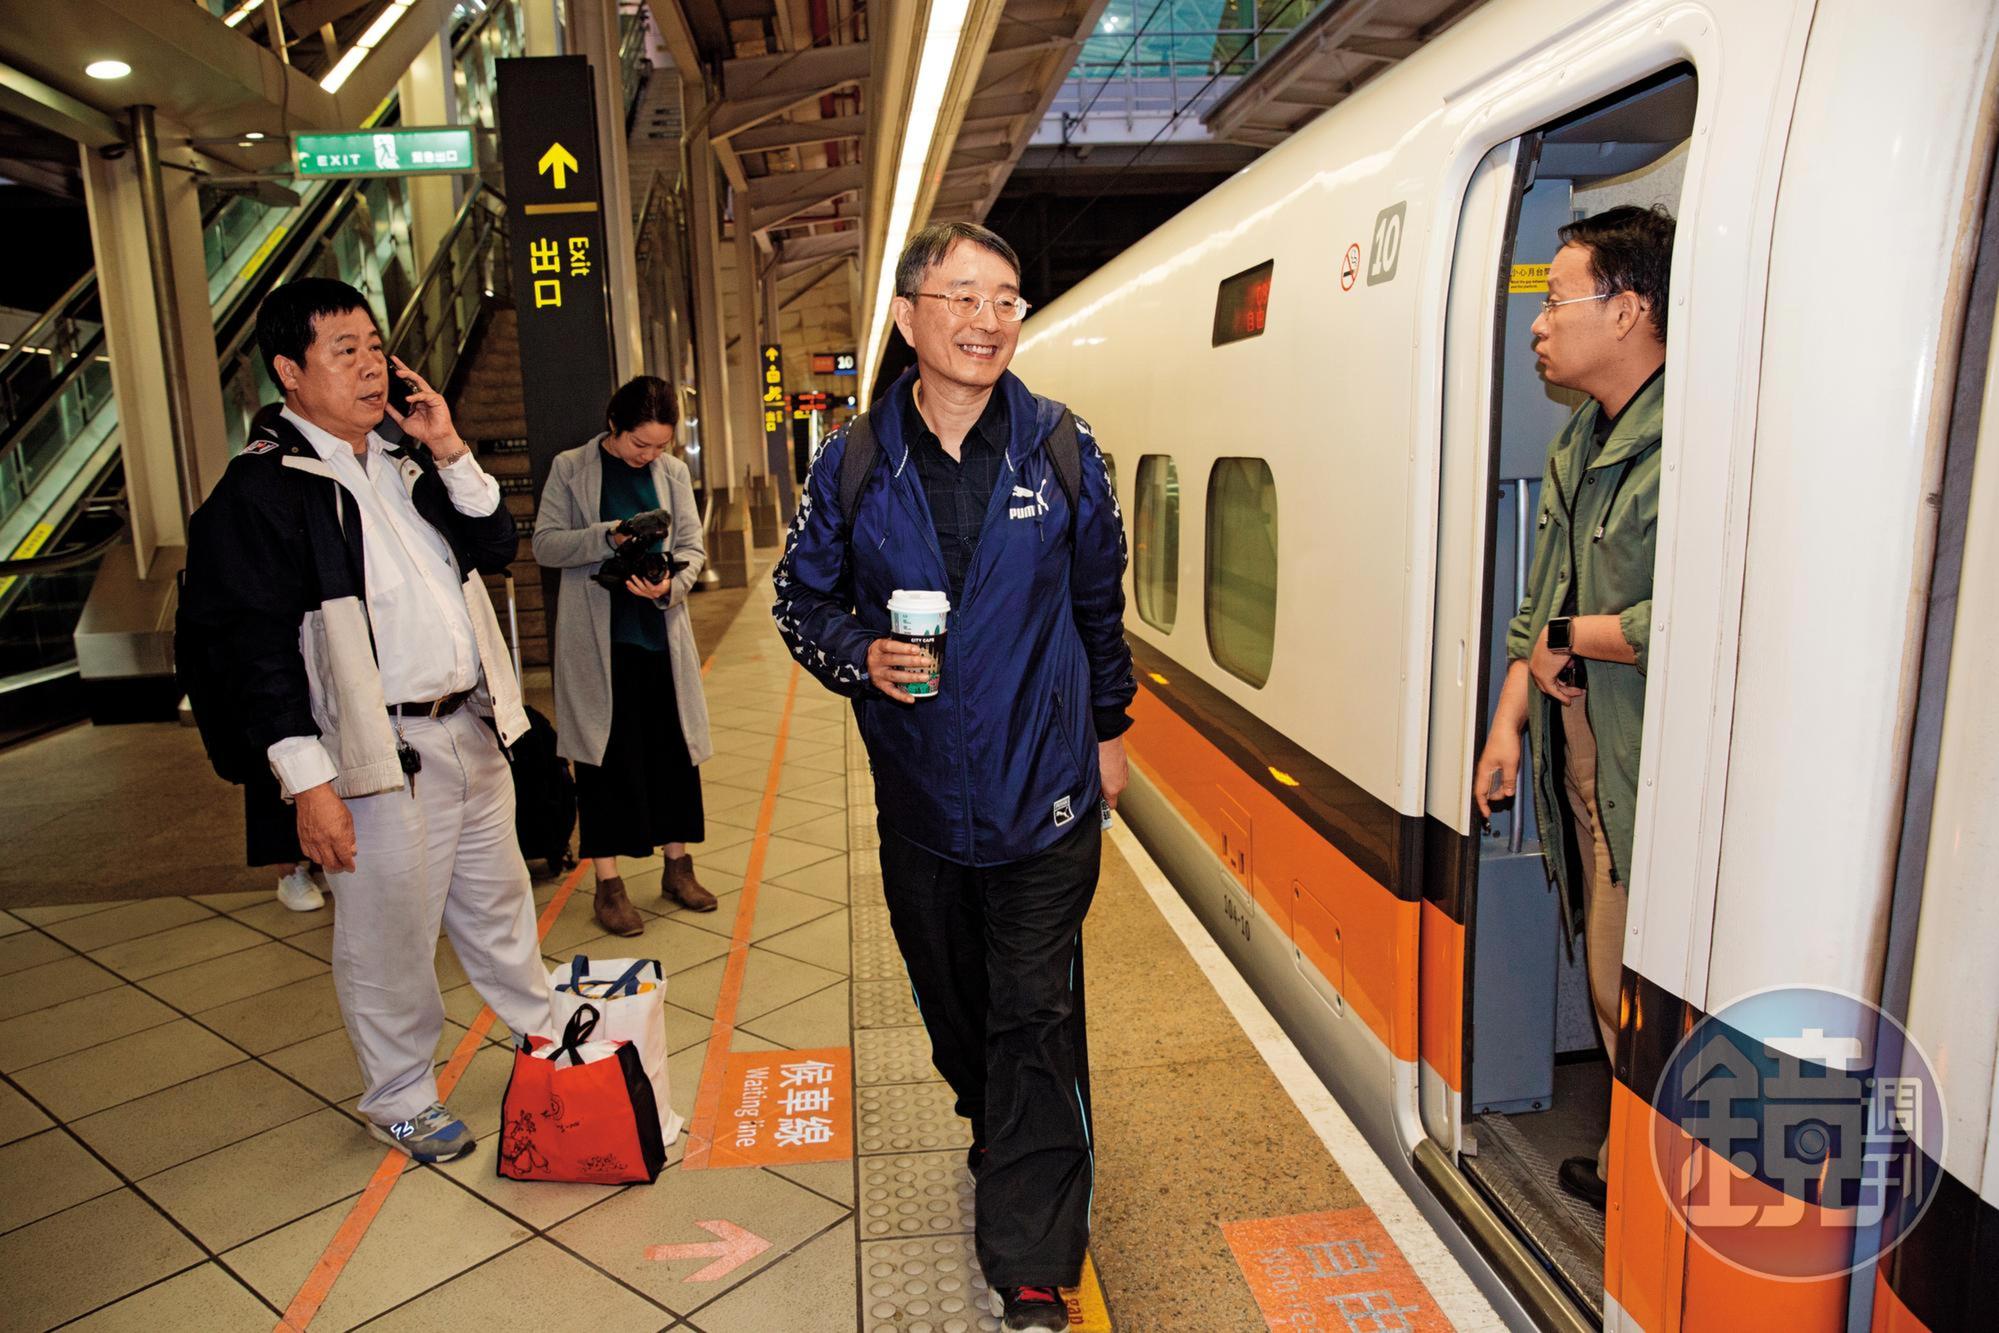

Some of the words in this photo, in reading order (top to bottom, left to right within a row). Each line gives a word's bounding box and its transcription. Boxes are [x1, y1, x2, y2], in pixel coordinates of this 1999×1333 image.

[317, 154, 360, 167] EXIT
[569, 237, 591, 277] Exit
[1371, 214, 1401, 276] 10
[530, 237, 561, 308] 出口
[837, 355, 855, 370] 10
[1223, 894, 1251, 942] 104-10
[734, 1066, 770, 1118] Waiting
[774, 1060, 836, 1148] 候車線
